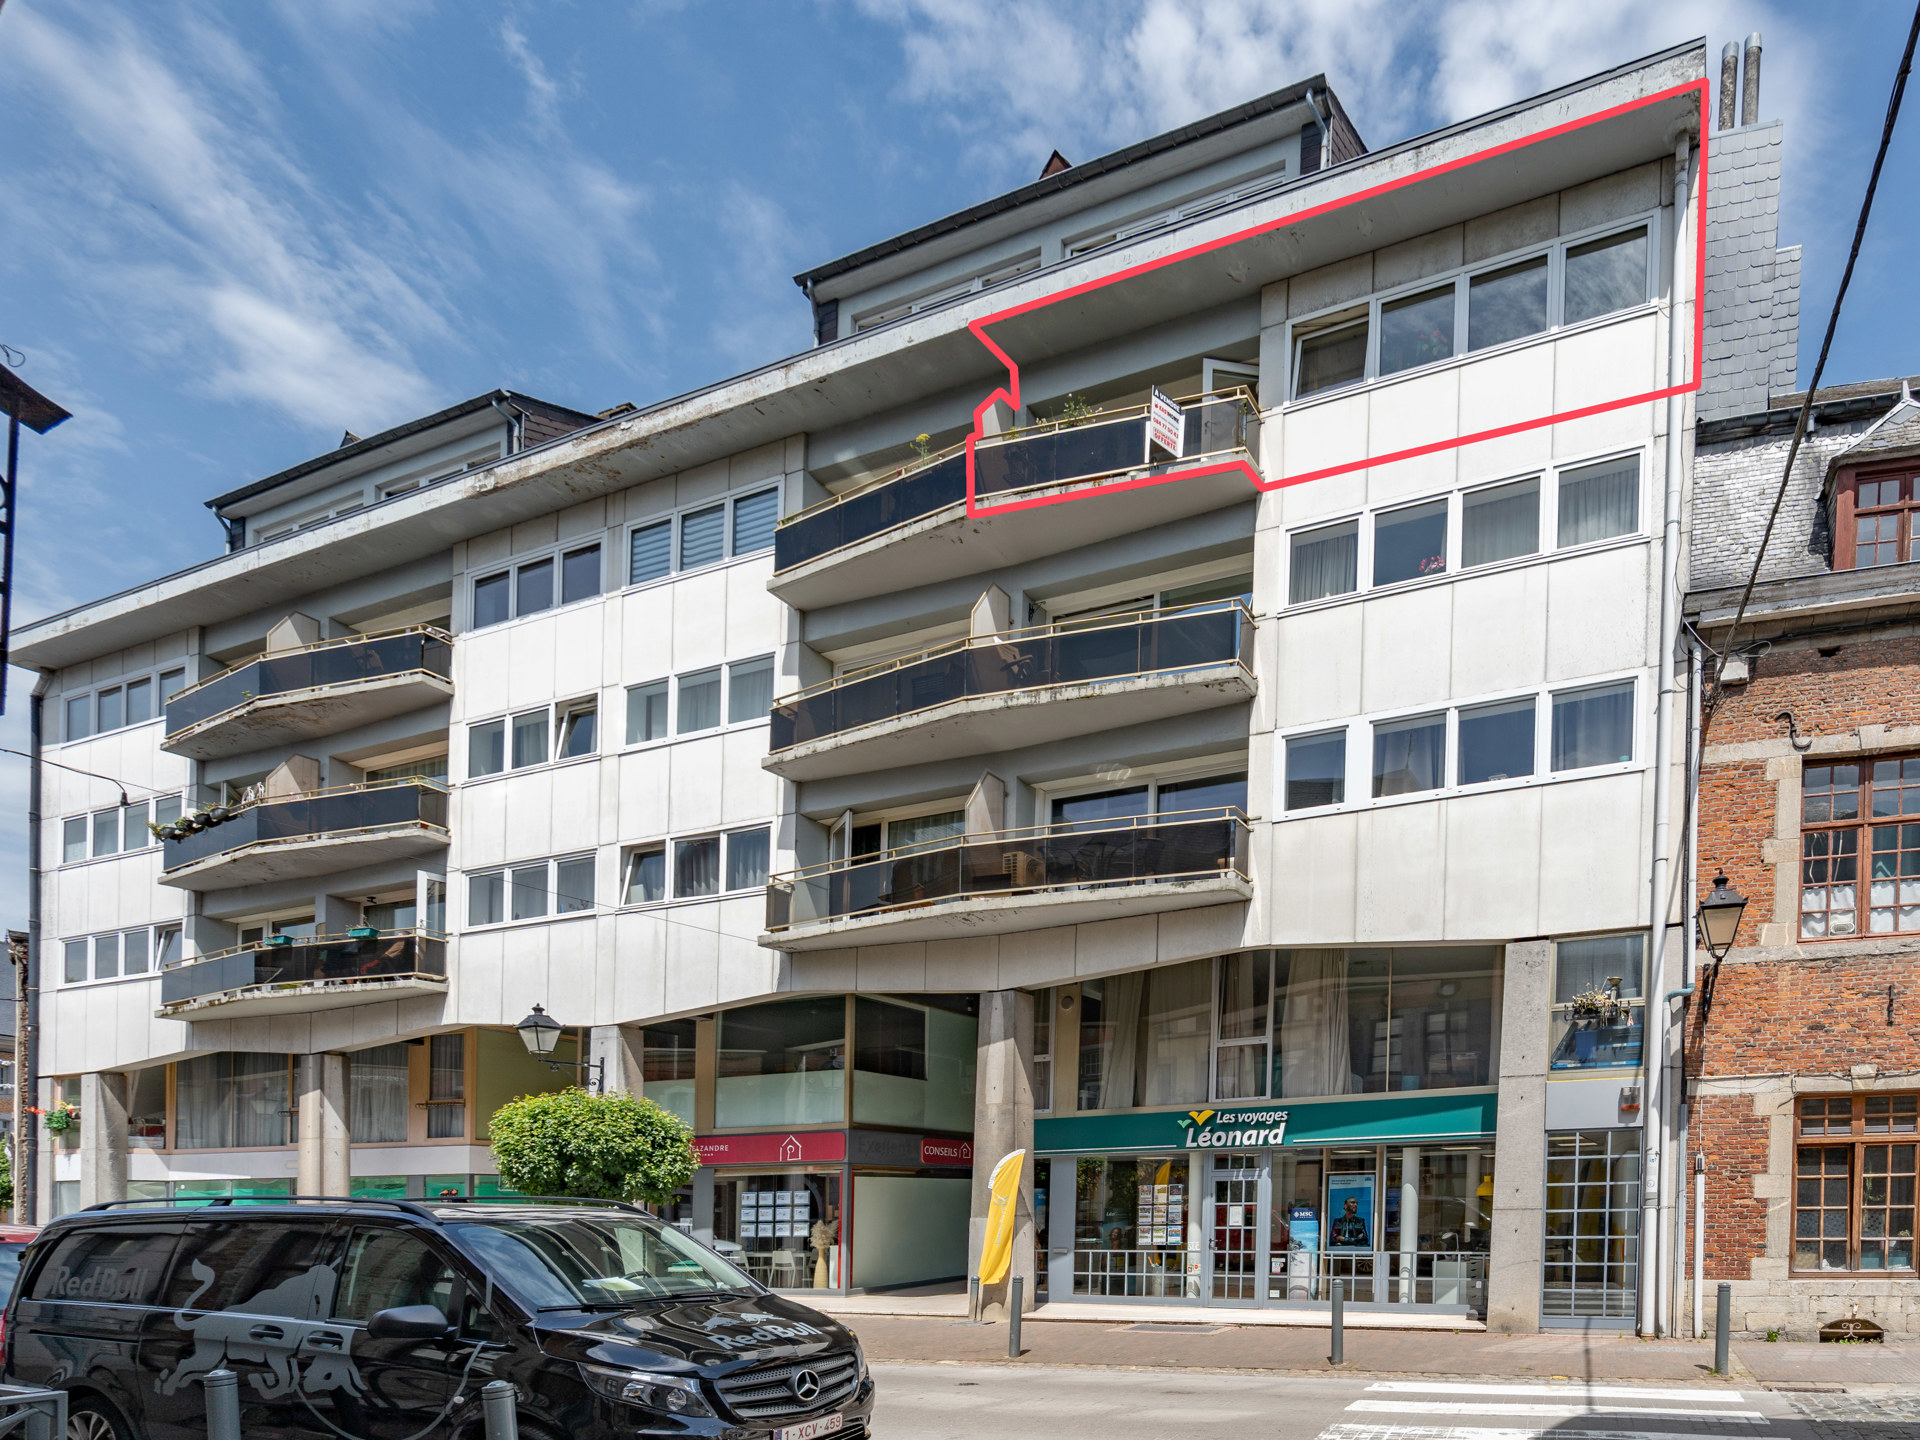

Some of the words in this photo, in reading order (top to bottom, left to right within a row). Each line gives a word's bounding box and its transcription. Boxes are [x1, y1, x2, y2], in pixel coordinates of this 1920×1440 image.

[1160, 392, 1181, 412] VENDRE
[1154, 433, 1176, 451] OFFERTE
[1216, 1111, 1236, 1124] Les
[1237, 1110, 1288, 1125] voyages
[1185, 1122, 1287, 1148] Léonard
[924, 1145, 958, 1157] CONSEILS
